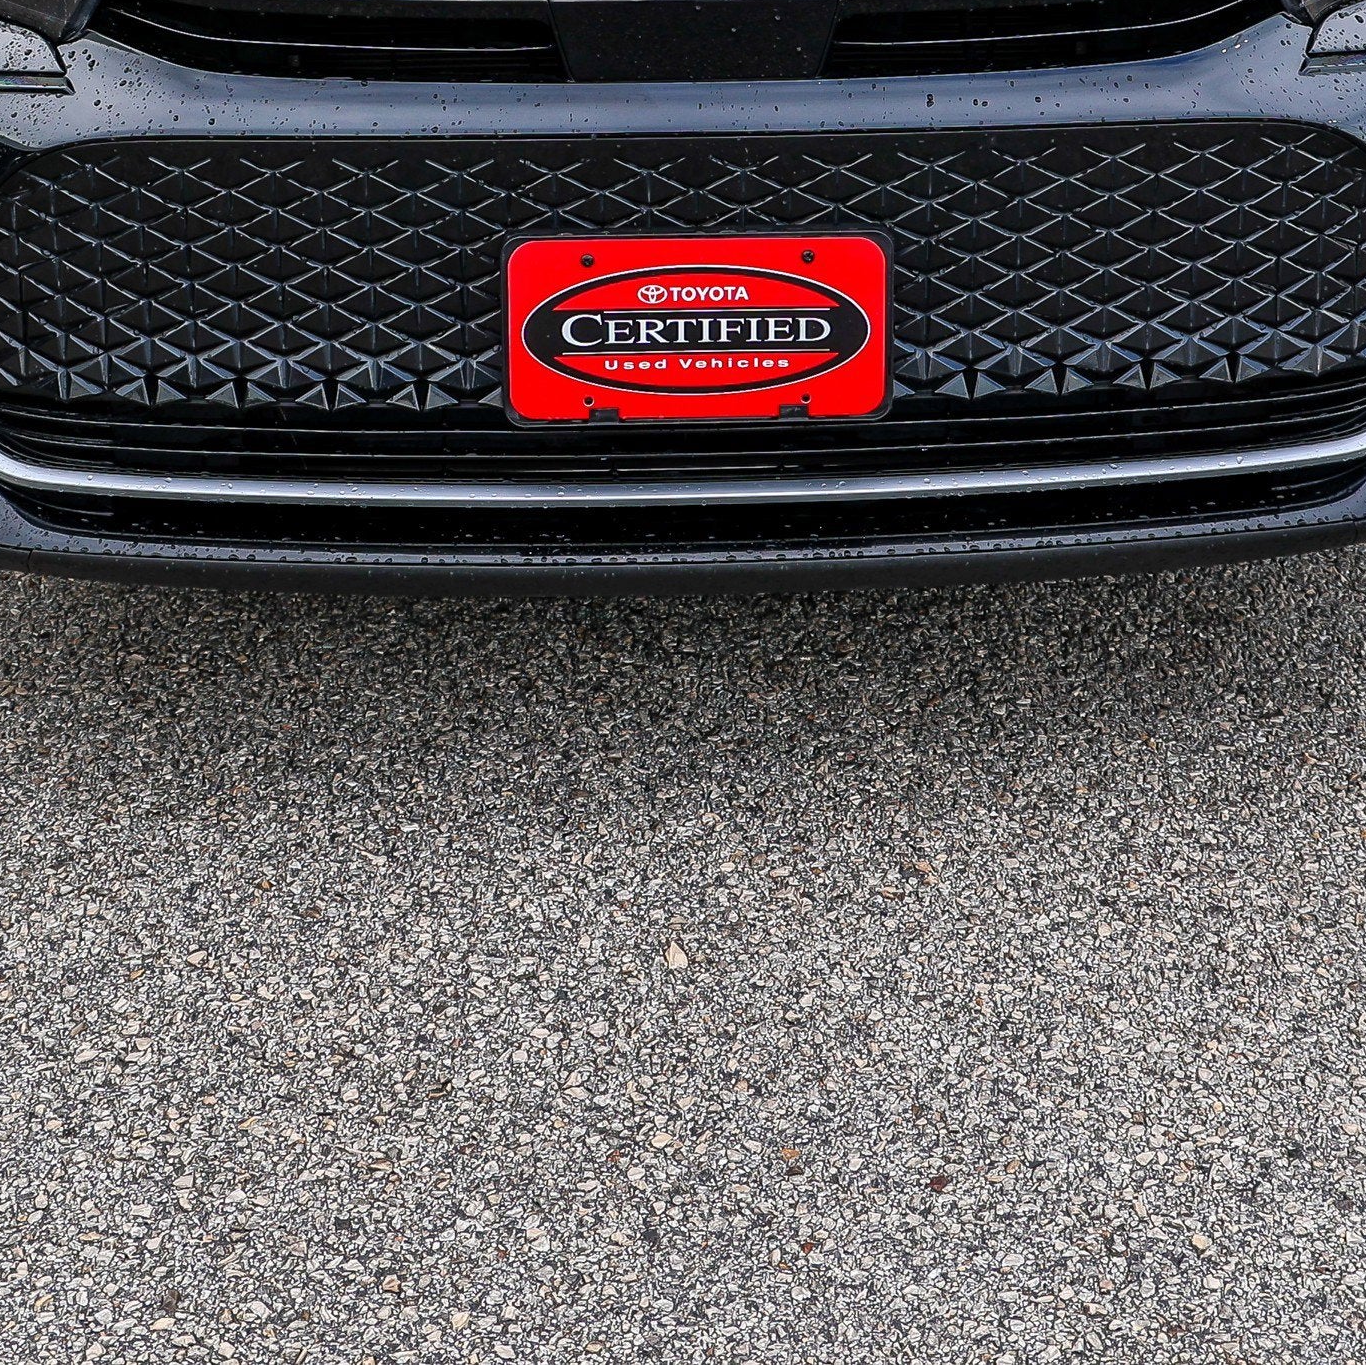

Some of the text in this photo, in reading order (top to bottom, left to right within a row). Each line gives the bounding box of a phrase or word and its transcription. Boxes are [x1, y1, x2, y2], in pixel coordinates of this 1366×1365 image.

[669, 286, 749, 302] TOYOTA
[561, 313, 831, 346] CERTIFIED
[604, 357, 790, 371] Used Vehicles
